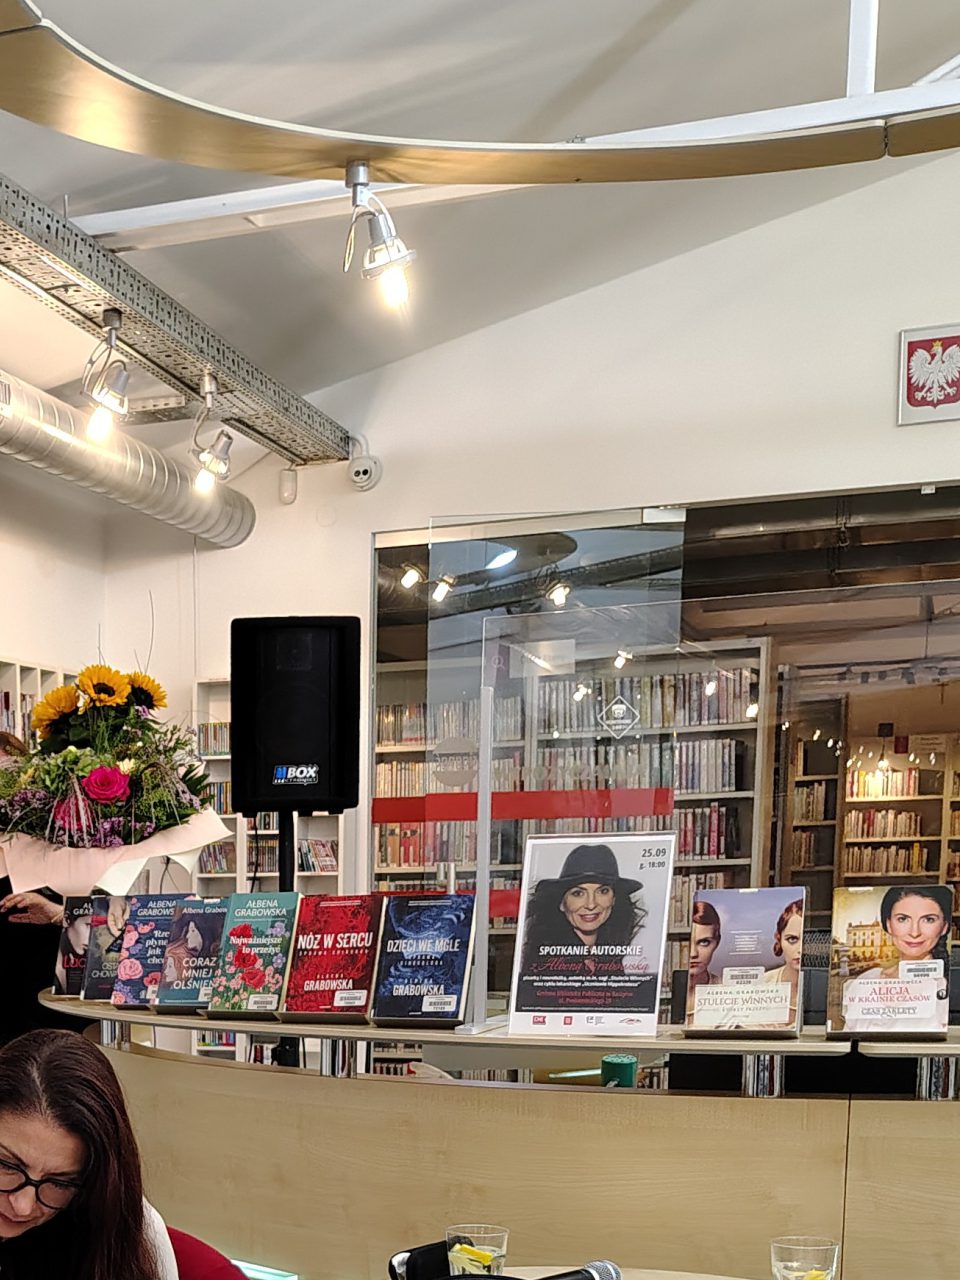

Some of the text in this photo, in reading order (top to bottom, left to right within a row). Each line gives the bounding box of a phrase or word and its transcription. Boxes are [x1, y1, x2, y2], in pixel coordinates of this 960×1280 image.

[641, 847, 667, 858] 25.09
[648, 861, 666, 869] 18:00
[147, 900, 177, 908] AŁBENA
[246, 899, 279, 908] AŁBENA
[234, 908, 288, 917] GRABOWSKA
[229, 935, 283, 947] Najważniejsze
[297, 932, 374, 950] NÓŻ W SERCU
[386, 939, 461, 953] DZIECI WE MGLE
[242, 945, 281, 955] to przeżyć
[539, 945, 642, 956] SPOTKANIE AUTORSKIE
[182, 957, 218, 967] CORAZ
[182, 968, 213, 979] MNIEJ
[304, 979, 353, 992] GRABOWSKA
[392, 984, 445, 996] GRABOWSKA
[869, 987, 910, 996] ALICJA
[697, 995, 788, 1007] STULECIE WINNYCH
[858, 995, 896, 1003] KRAINIE
[896, 993, 930, 1002] CZASÓW
[861, 1006, 918, 1018] CZAS ZAKLĘTY
